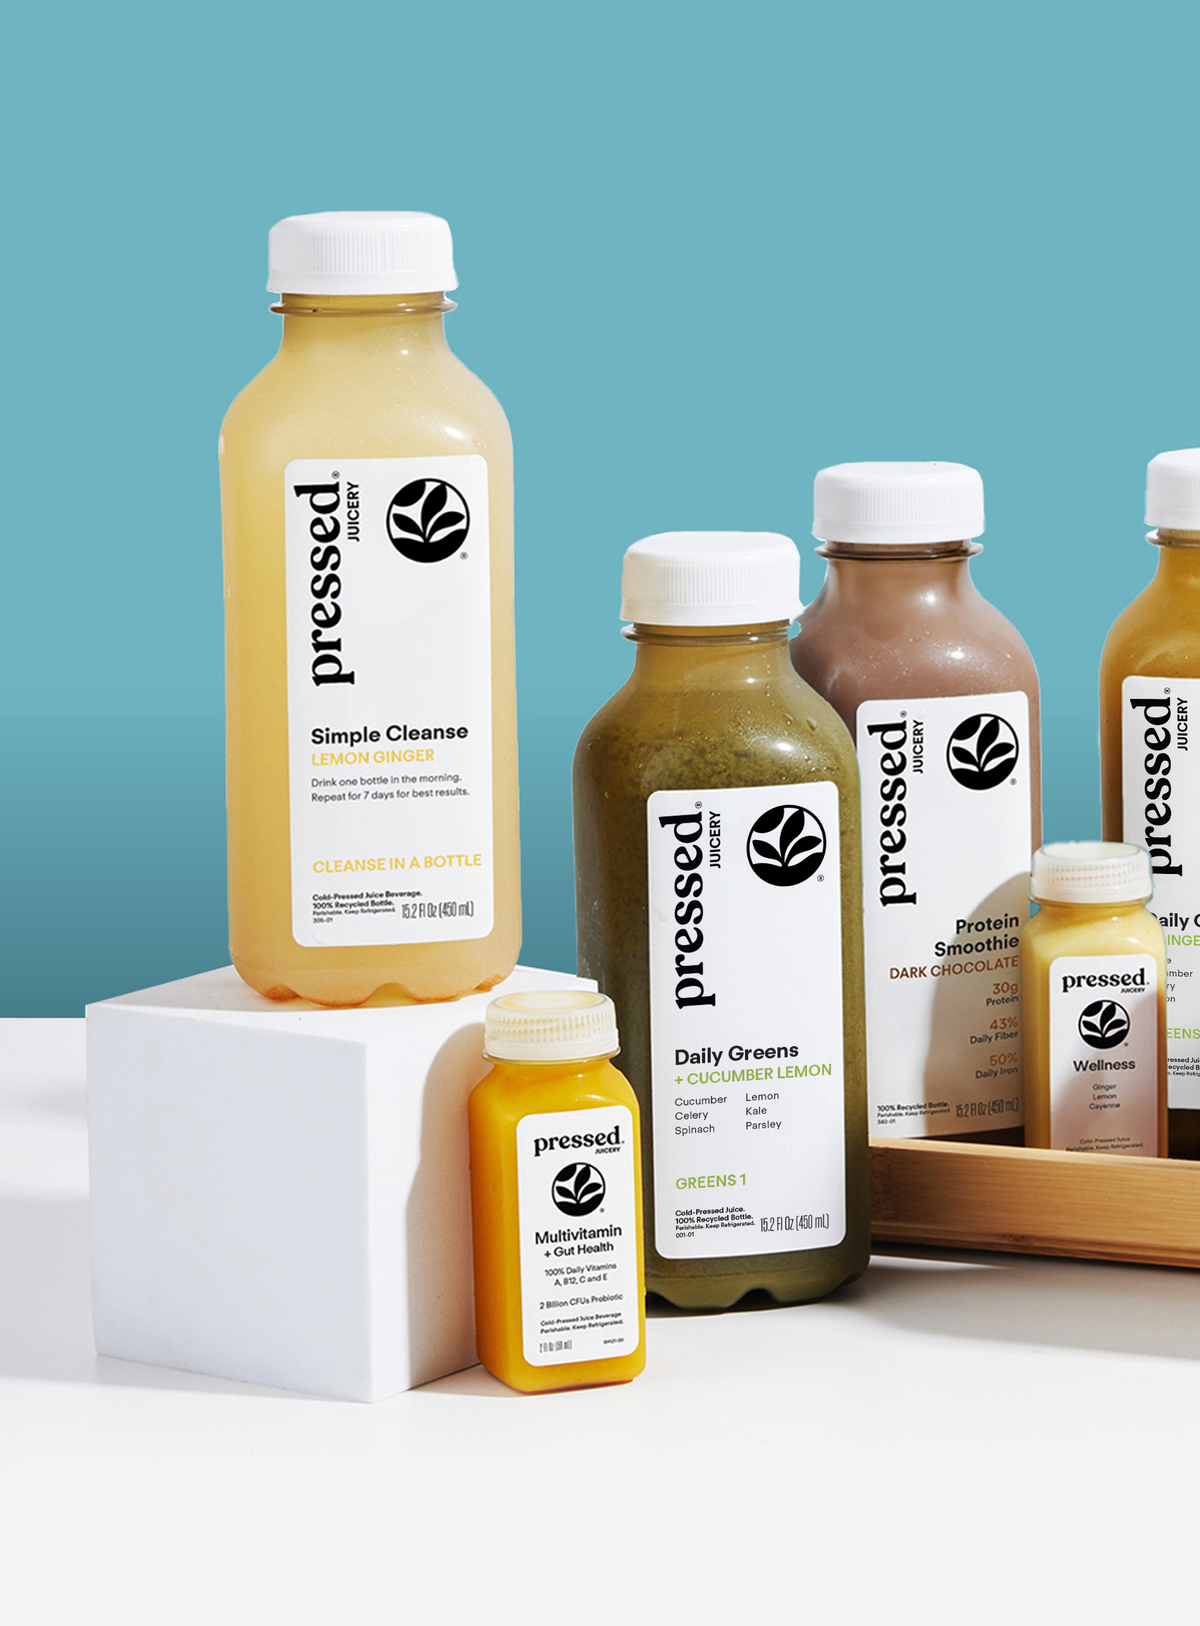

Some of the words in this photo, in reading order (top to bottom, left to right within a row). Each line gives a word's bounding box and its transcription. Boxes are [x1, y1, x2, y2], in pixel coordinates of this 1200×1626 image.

[347, 482, 360, 542] JUICERY
[294, 482, 355, 686] pressed
[1177, 698, 1188, 751] JUICERY
[312, 726, 380, 747] Simple
[386, 725, 468, 741] Cleanse
[913, 720, 923, 774] JUICERY
[312, 752, 369, 766] LEMON
[373, 749, 434, 763] GINGER
[419, 773, 462, 784] morning.
[312, 793, 346, 803] Repeat
[867, 720, 916, 906] pressed
[710, 811, 720, 868] JUICERY
[313, 858, 385, 873] CLEANSE
[390, 858, 405, 870] IN
[409, 857, 420, 869] A
[424, 854, 482, 868] BOTTLE
[659, 811, 716, 1009] pressed
[956, 913, 1019, 934] Protein
[1152, 913, 1189, 931] aily
[934, 934, 1019, 957] Smoothie
[890, 966, 927, 979] DARK
[931, 955, 1019, 977] CHOCOLATE
[992, 982, 1018, 995] 30g
[1062, 968, 1145, 993] pressed
[986, 995, 1019, 1006] Protein
[990, 1016, 1018, 1030] 43%
[995, 1031, 1018, 1041] Fiber
[676, 1048, 723, 1066] Daily
[728, 1046, 798, 1061] Greens
[990, 1052, 1018, 1066] 50%
[1073, 1057, 1135, 1072] Wellness
[687, 1068, 773, 1085] CUCUMBER
[778, 1064, 831, 1078] LEMON
[675, 1096, 727, 1106] Cucumber
[675, 1124, 715, 1136] Spinach
[534, 1125, 620, 1157] pressed
[676, 1174, 736, 1189] GREENS
[740, 1174, 745, 1185] 1
[536, 1224, 622, 1244] Multivitamin
[554, 1246, 574, 1257] Gut
[578, 1242, 614, 1254] Health
